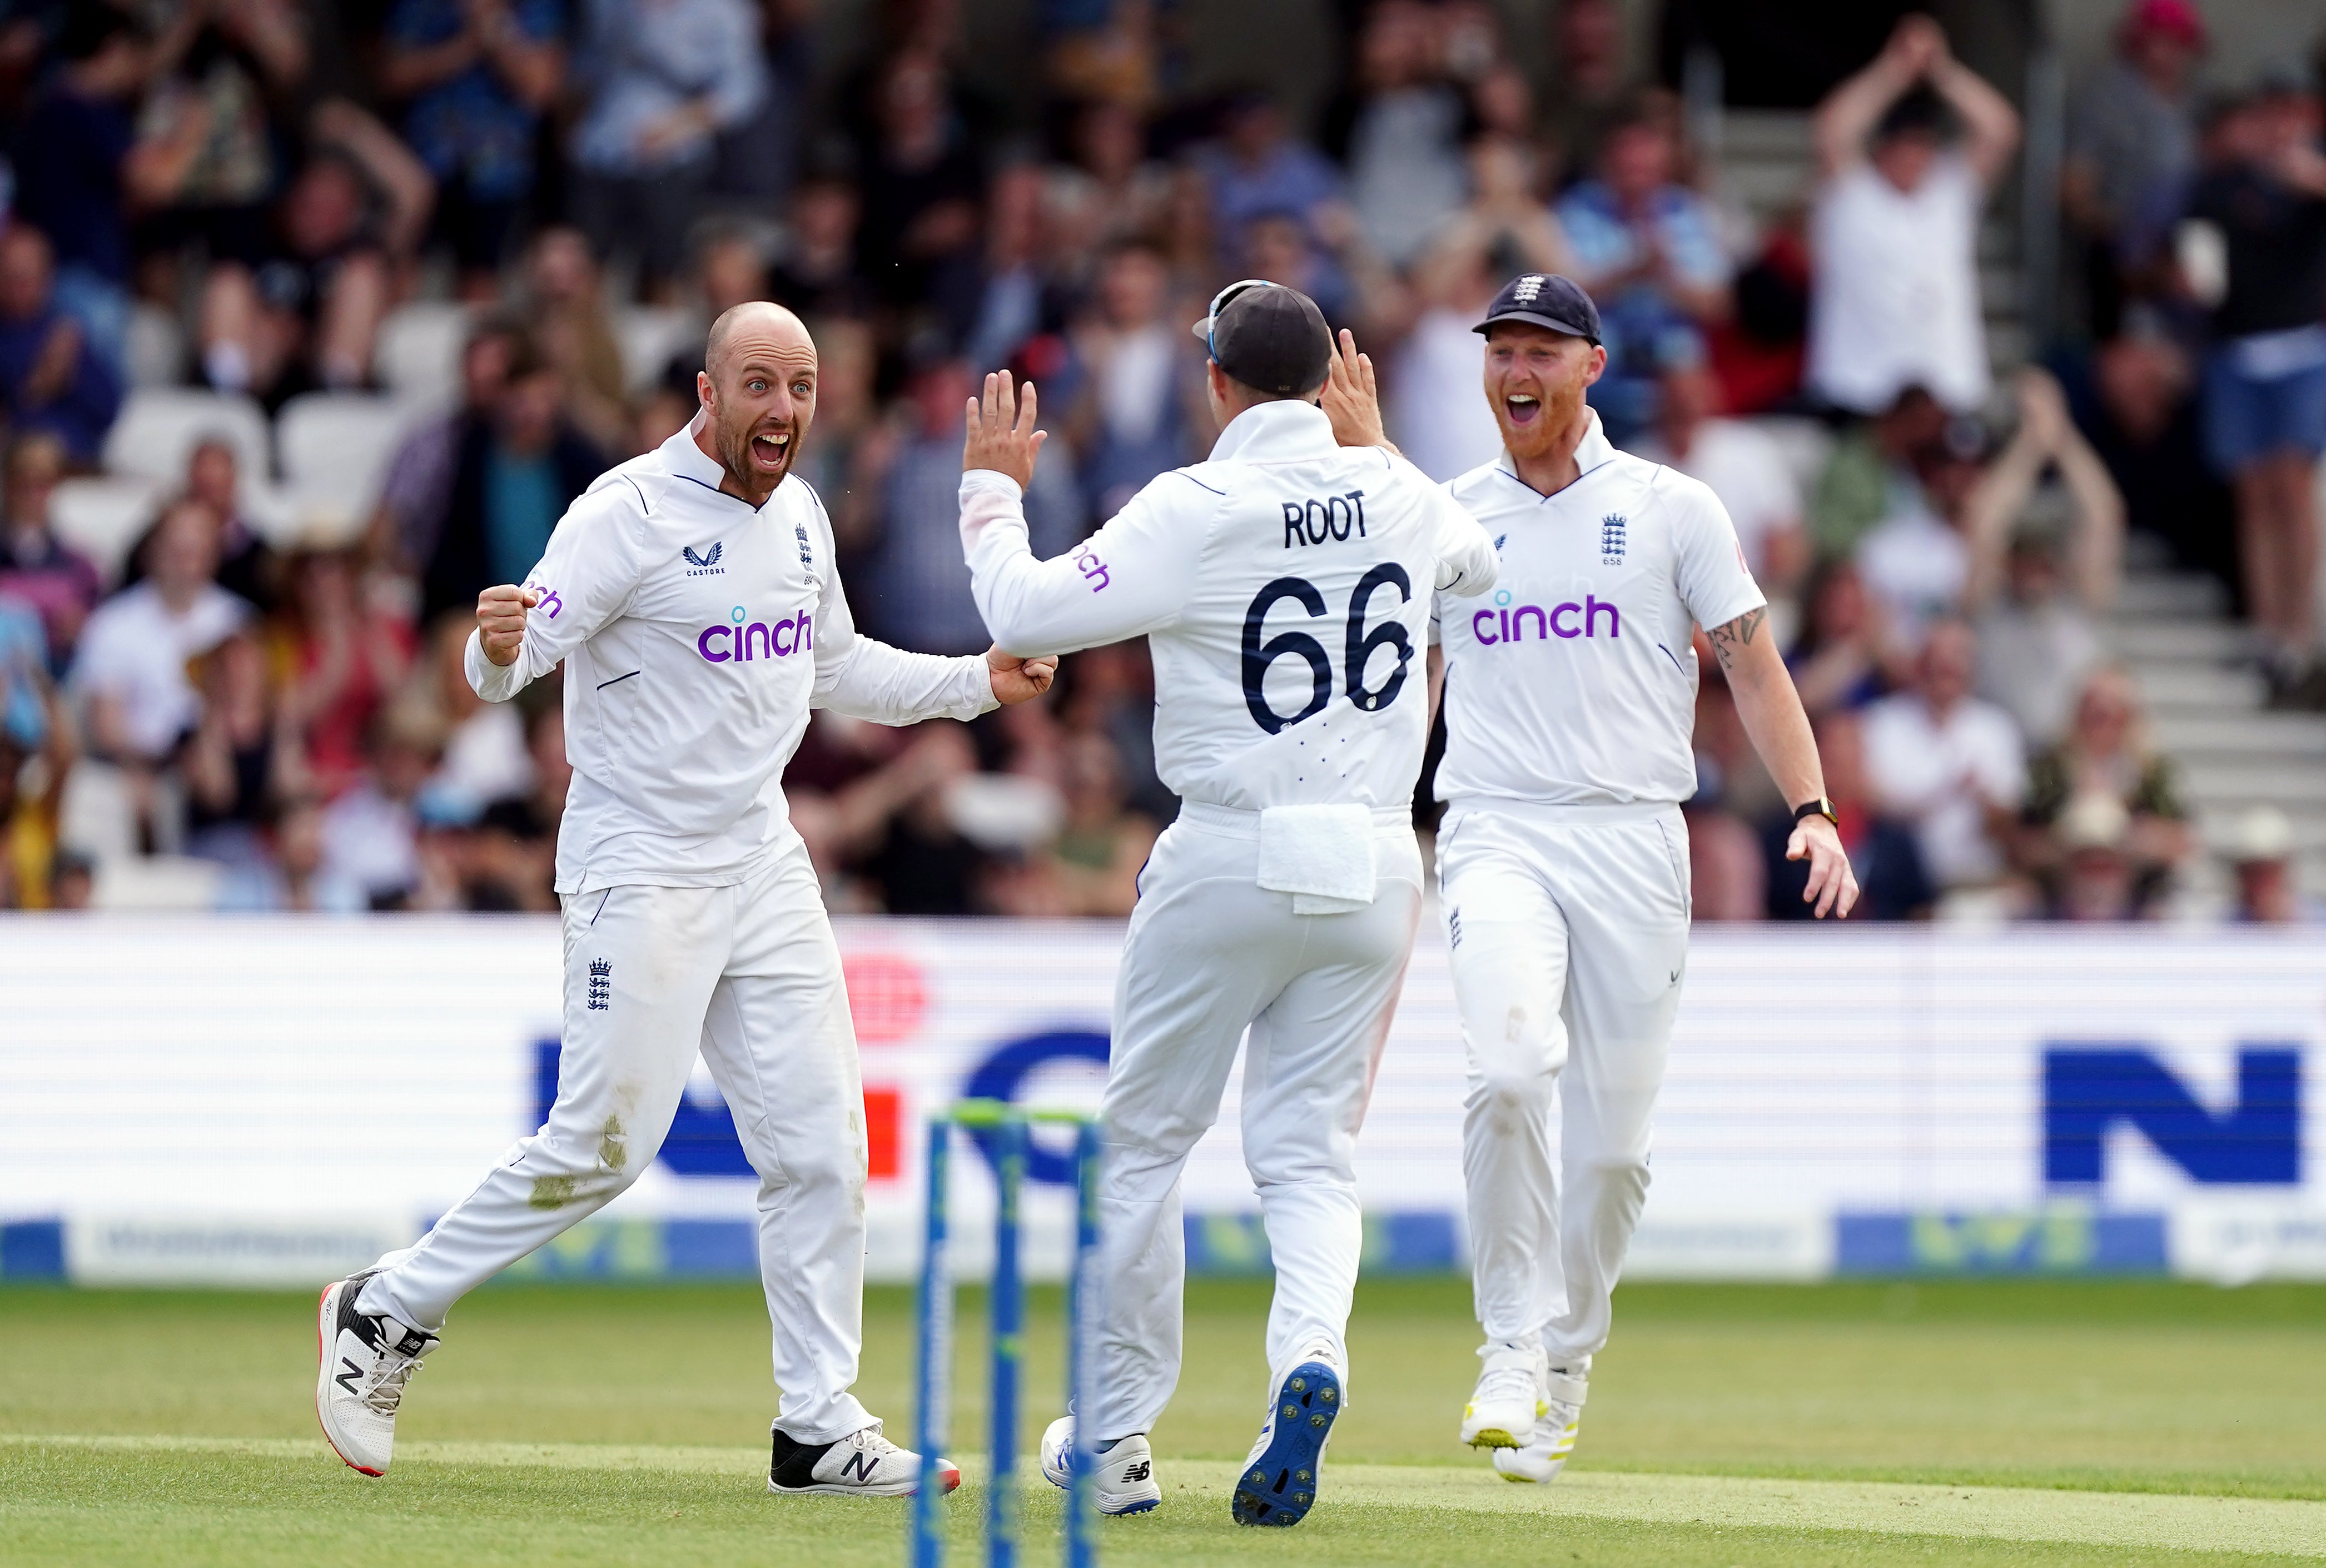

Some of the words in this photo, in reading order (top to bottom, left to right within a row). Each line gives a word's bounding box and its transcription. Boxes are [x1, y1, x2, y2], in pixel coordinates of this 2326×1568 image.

[1281, 490, 1366, 549] ROOT
[687, 568, 725, 576] CASTORE
[1603, 557, 1622, 565] 658
[698, 606, 812, 663] cinch
[1473, 590, 1620, 645] cinch
[1241, 562, 1414, 735] 66
